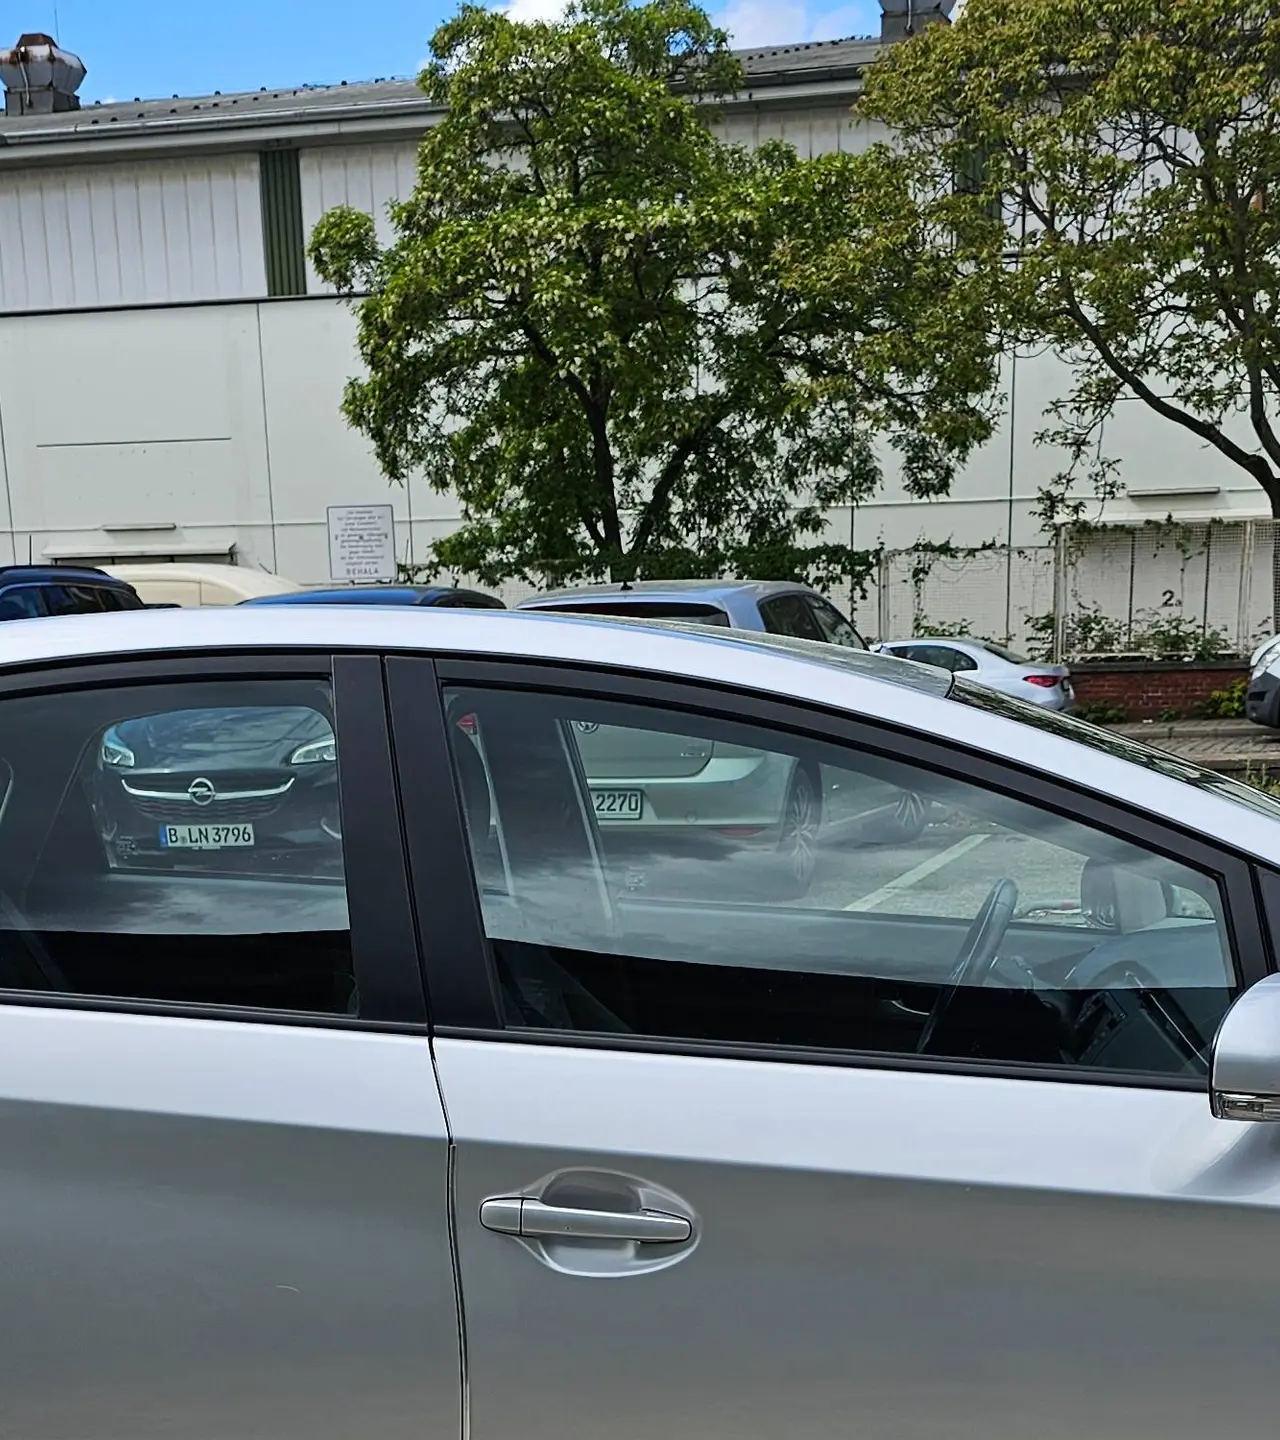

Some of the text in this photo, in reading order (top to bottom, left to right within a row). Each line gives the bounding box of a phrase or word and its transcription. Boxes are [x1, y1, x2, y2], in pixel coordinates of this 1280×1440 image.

[596, 792, 638, 812] 2270
[168, 826, 251, 843] B LN 3796
